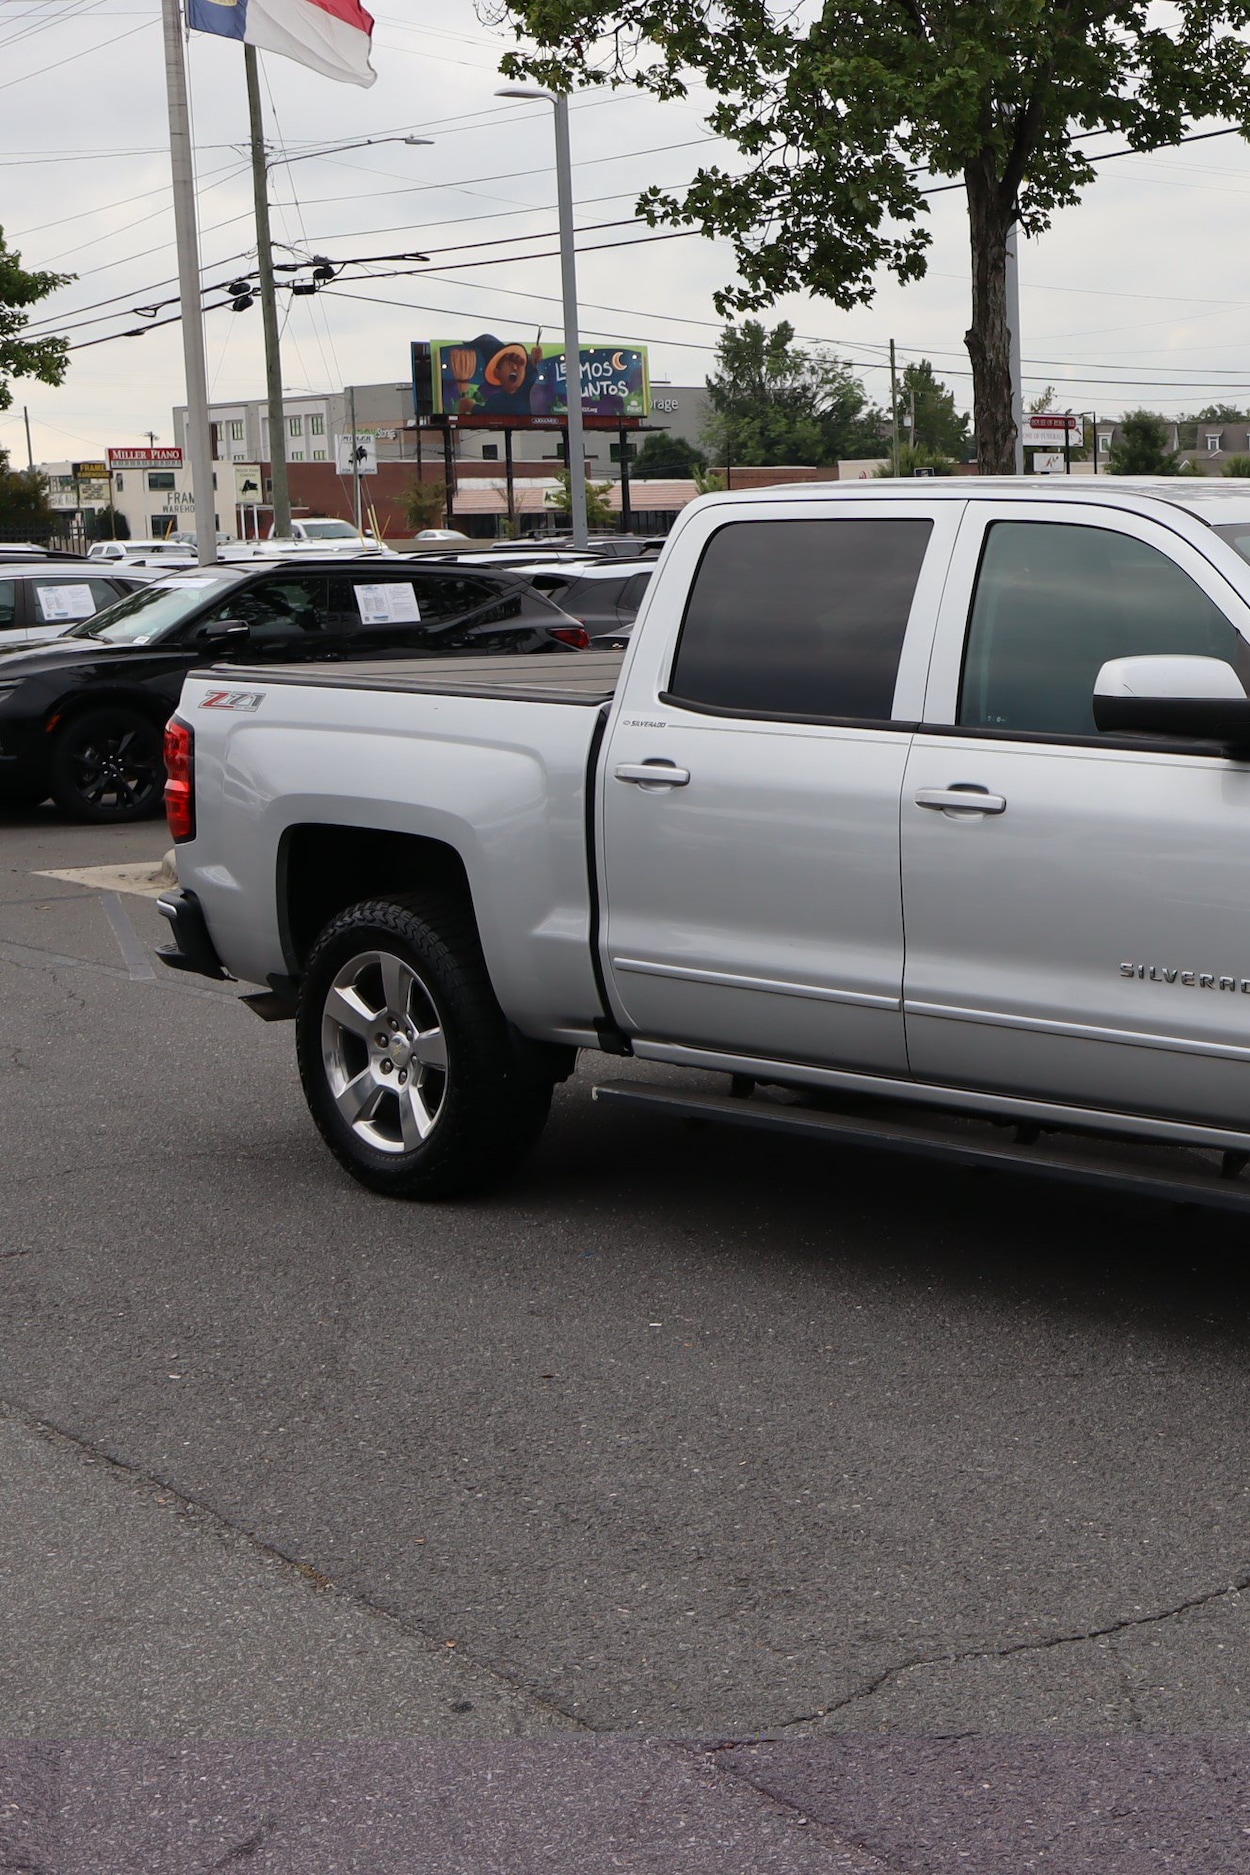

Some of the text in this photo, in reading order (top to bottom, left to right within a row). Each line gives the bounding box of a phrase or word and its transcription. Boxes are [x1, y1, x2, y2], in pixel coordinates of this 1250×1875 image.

[555, 361, 613, 381] LEMOS
[565, 380, 629, 397] UNTOS
[112, 449, 179, 460] MILLER PIANO
[167, 491, 195, 505] FRAM
[162, 504, 195, 513] WAREHO
[198, 690, 266, 712] Z71
[630, 720, 667, 729] SILVERADO
